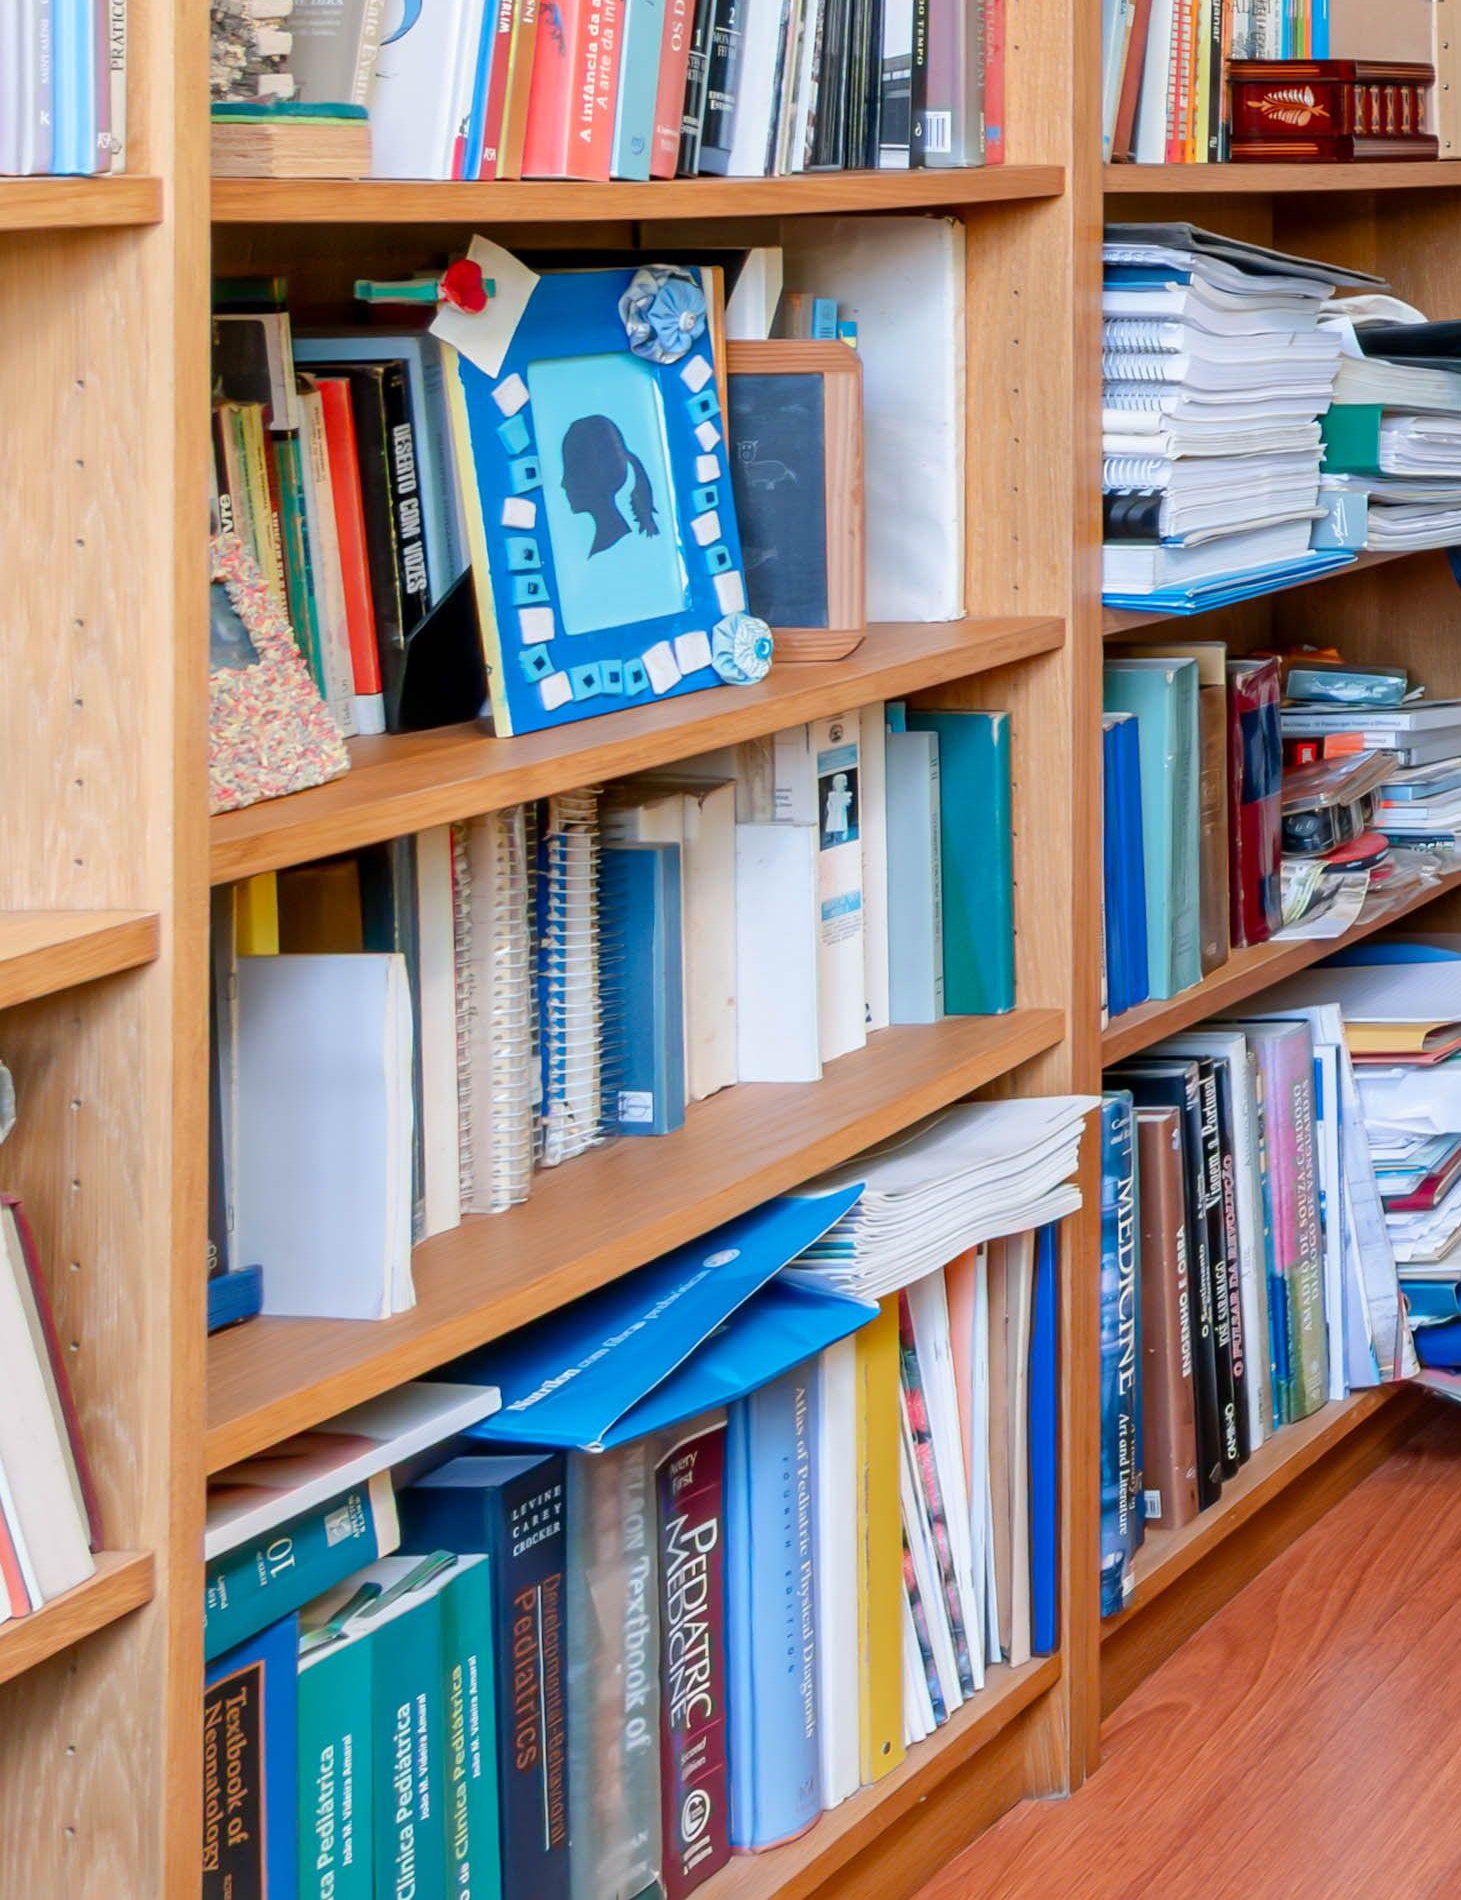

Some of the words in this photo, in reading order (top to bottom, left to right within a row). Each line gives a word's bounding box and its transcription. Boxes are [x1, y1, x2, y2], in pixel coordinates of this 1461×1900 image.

[589, 19, 602, 47] da
[603, 10, 614, 39] da
[670, 24, 683, 53] OS
[727, 6, 736, 25] 2
[600, 44, 611, 91] arte
[915, 20, 926, 66] TEMPO
[583, 51, 600, 124] infância
[597, 95, 608, 110] A
[581, 128, 593, 142] A
[393, 423, 416, 495] DESERTO
[399, 498, 421, 539] COM
[403, 542, 427, 595] VOZES
[1202, 1075, 1218, 1133] Portugal
[1301, 1078, 1316, 1210] VANGUARDAS
[1205, 1150, 1219, 1211] Viagem
[1223, 1153, 1239, 1263] REVOLUÇÃO
[1175, 1226, 1187, 1281] OBRA
[1228, 1266, 1241, 1291] DA
[1308, 1245, 1321, 1301] DIÁLOGO
[1115, 1178, 1135, 1396] MEDICINE
[1216, 1259, 1229, 1311] SARAMAGO
[1180, 1304, 1193, 1379] ENGENHO
[1218, 1313, 1230, 1348] JOSÉ
[1230, 1294, 1242, 1361] PULSAR
[1232, 1364, 1242, 1378] O
[794, 1387, 809, 1439] Atlas
[1118, 1413, 1130, 1438] Art
[1227, 1401, 1237, 1461] CAMINHO
[795, 1443, 808, 1462] of
[1119, 1440, 1131, 1466] and
[511, 1484, 562, 1522] LEVINE
[511, 1503, 562, 1540] CAREY
[782, 1456, 792, 1550] FOURTH
[796, 1464, 813, 1560] Pediatric
[1119, 1468, 1131, 1536] Literature
[266, 1536, 296, 1578] 10
[511, 1521, 562, 1558] CROCKER
[665, 1513, 686, 1729] MEDICINE
[682, 1515, 719, 1727] PEDIATRIC
[785, 1570, 796, 1675] EDITION
[800, 1564, 815, 1641] Physical
[467, 1654, 477, 1700] Amaral
[511, 1583, 539, 1775] Pediatrics
[803, 1644, 817, 1739] Diagnosis
[416, 1693, 427, 1740] Amaral
[449, 1664, 465, 1784] Pediátrica
[469, 1702, 479, 1738] Videira
[226, 1686, 250, 1815] Textbook
[341, 1733, 353, 1781] Amaral
[393, 1701, 413, 1821] Pediátrica
[418, 1742, 429, 1780] Videira
[471, 1755, 481, 1779] João
[203, 1699, 226, 1872] Neonatology
[316, 1744, 336, 1872] Pediátrica
[341, 1783, 352, 1822] Videira
[419, 1797, 430, 1821] João
[228, 1817, 249, 1848] of
[453, 1785, 468, 1861] Clínica
[341, 1841, 352, 1867] João
[395, 1824, 415, 1900] Clínica
[457, 1863, 470, 1885] de
